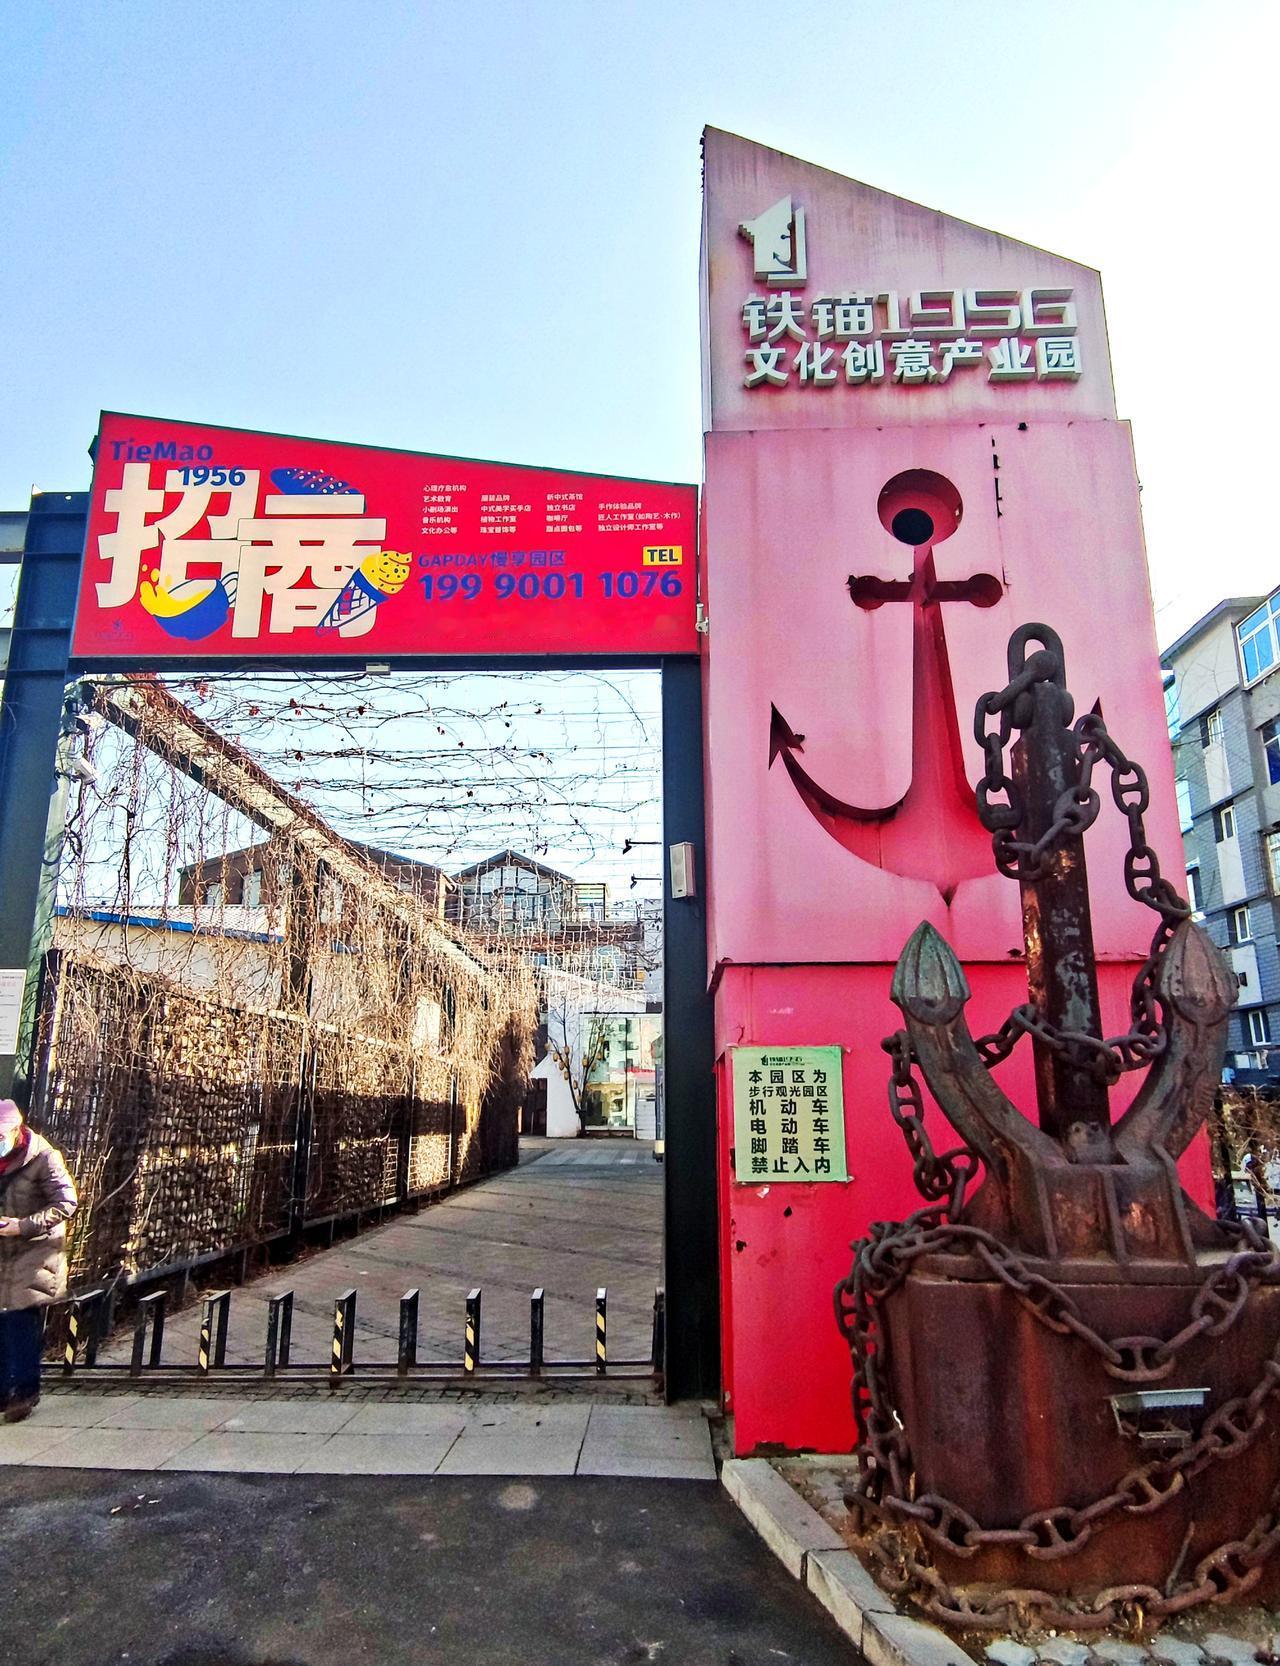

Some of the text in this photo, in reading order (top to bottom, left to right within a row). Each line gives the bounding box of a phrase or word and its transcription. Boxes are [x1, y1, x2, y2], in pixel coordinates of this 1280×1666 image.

[742, 287, 1079, 344] 铁锚1956
[743, 337, 1083, 388] 文化创意产业园
[110, 439, 214, 462] TieMao
[177, 466, 246, 487] 1956
[423, 484, 467, 492] 心理疗愈机构
[423, 495, 452, 503] 艺术教育
[480, 494, 510, 502] 服装品牌
[546, 493, 583, 501] 新中式茶馆
[422, 505, 459, 513] 小剧场演出
[480, 504, 532, 513] 中式美学买手店
[546, 504, 576, 512] 独立书店
[598, 502, 642, 510] 手作体验品牌
[422, 516, 451, 524] 音乐机构
[480, 515, 517, 523] 植物工作室
[546, 514, 568, 522] 咖啡厅
[421, 526, 458, 535] 文化办公等
[480, 526, 516, 534] 珠宝首饰等
[598, 523, 664, 532] 独立设计师工作室等
[95, 462, 387, 638] 招商
[647, 548, 679, 562] TEL
[418, 570, 683, 601] 199 9001 1076
[748, 1069, 828, 1084] 本园区为
[749, 1085, 828, 1098] 步行观光园区
[749, 1099, 829, 1116] 机动车
[750, 1117, 830, 1135] 电动车
[751, 1137, 831, 1155] 脚踏车
[751, 1156, 831, 1174] 禁止入内
